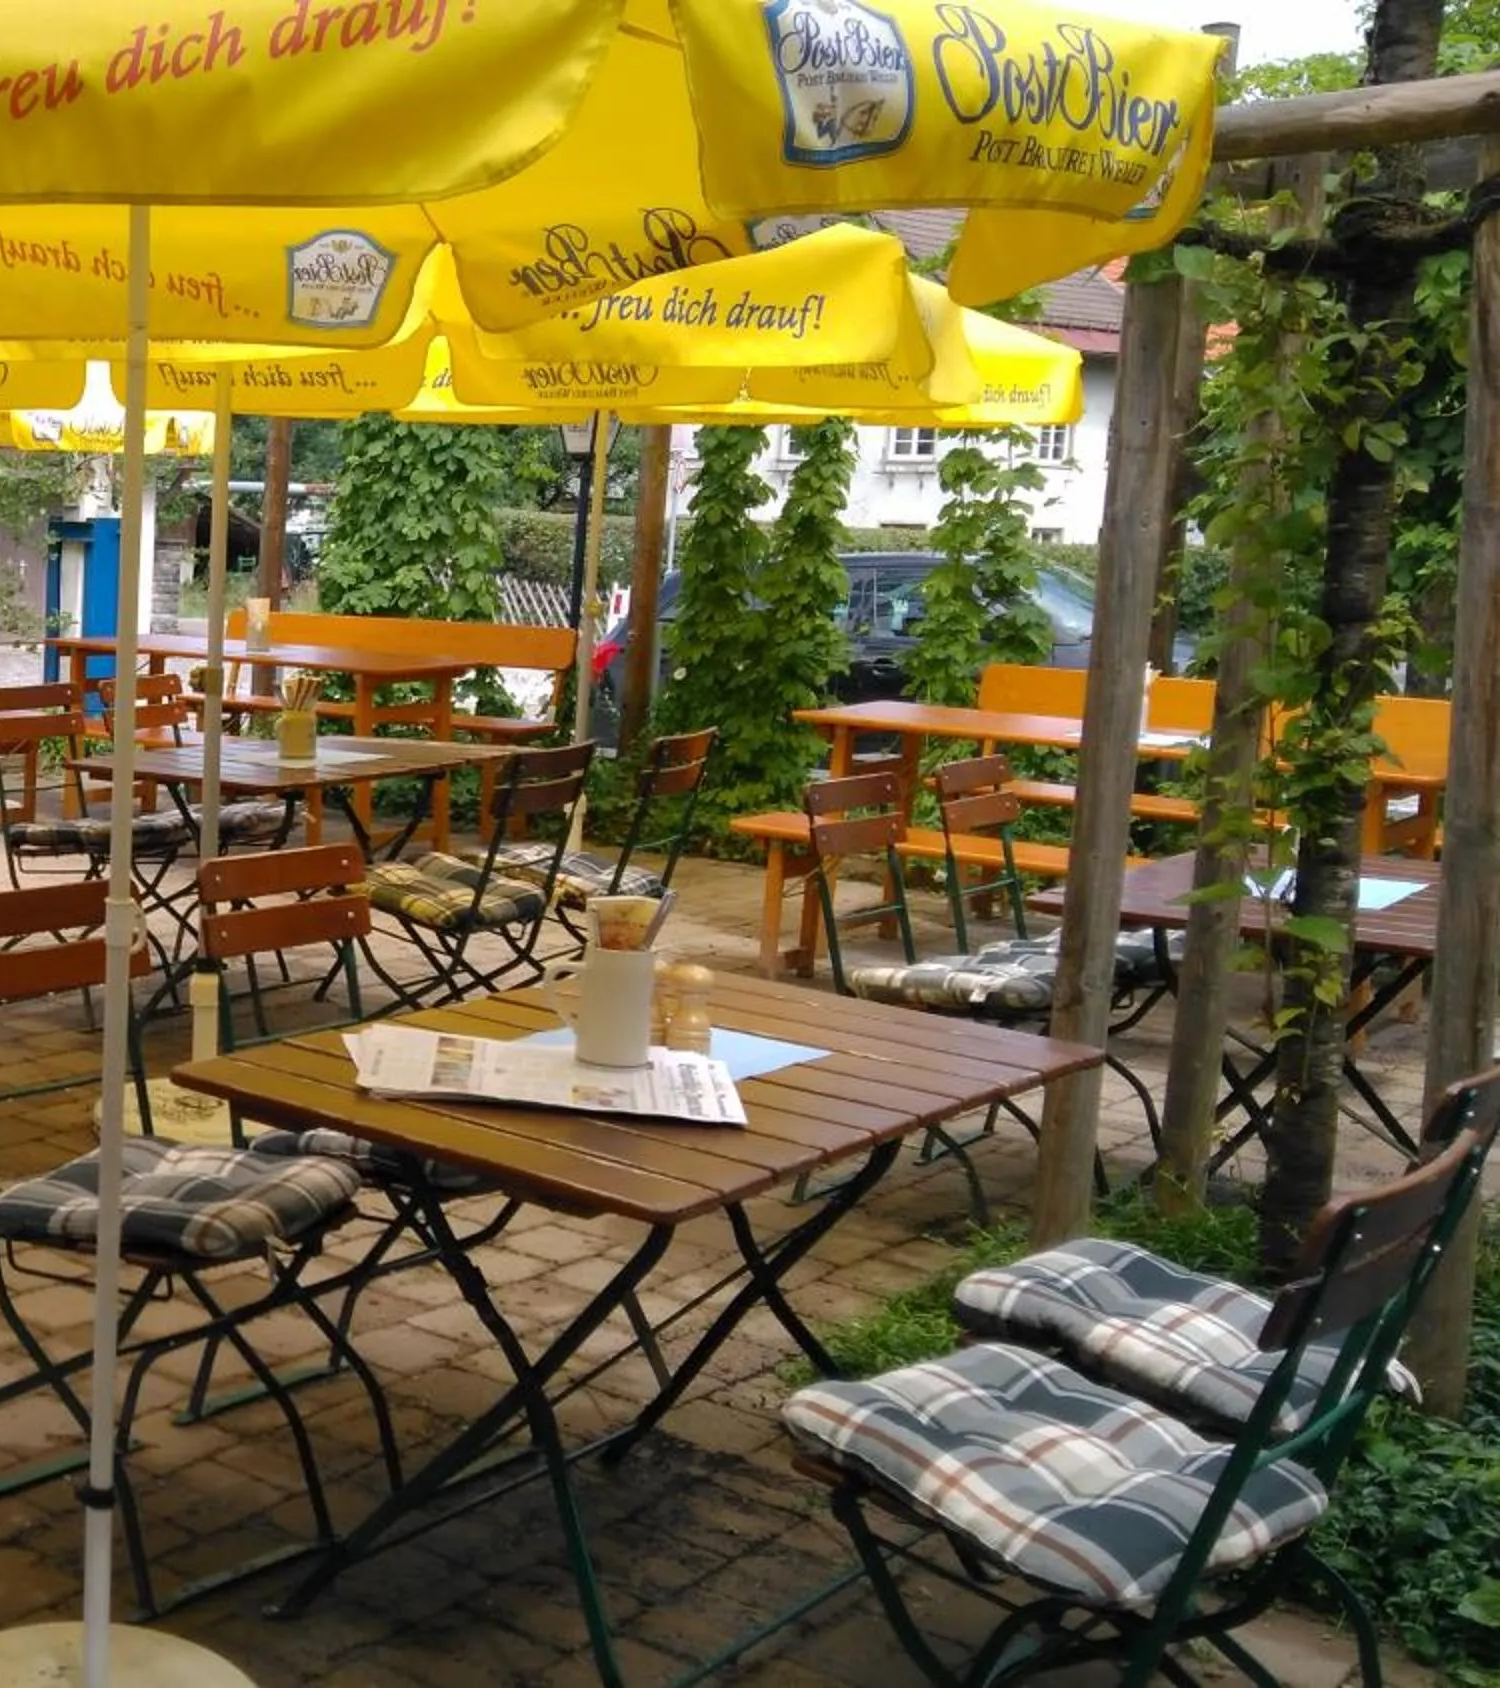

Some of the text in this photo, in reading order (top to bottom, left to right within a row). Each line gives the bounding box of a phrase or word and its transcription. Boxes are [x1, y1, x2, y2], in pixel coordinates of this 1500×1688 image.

[104, 11, 247, 95] dich
[663, 285, 718, 327] dich
[725, 289, 825, 339] drauf!
